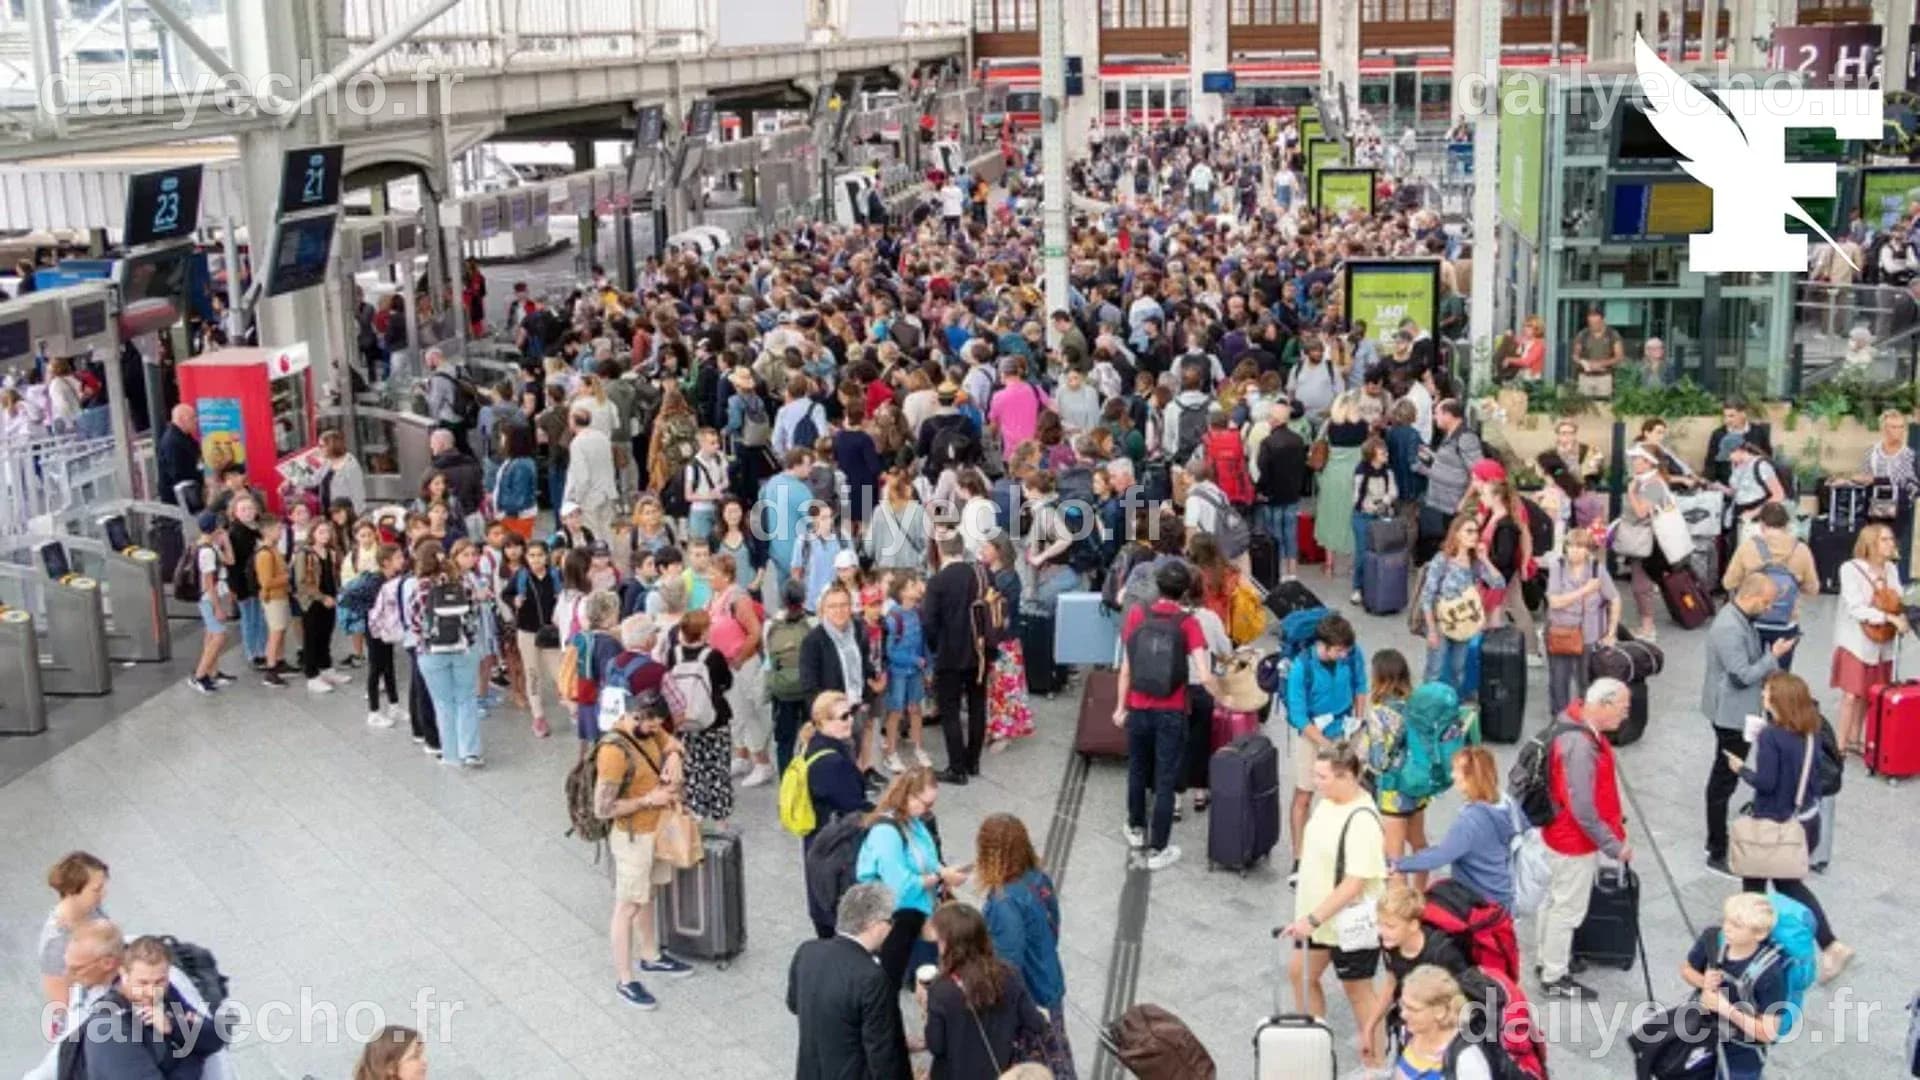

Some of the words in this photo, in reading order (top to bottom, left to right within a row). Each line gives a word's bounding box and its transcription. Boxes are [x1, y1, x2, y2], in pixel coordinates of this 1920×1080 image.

[1799, 44, 1817, 77] 2
[304, 168, 325, 196] 21
[155, 193, 179, 225] 23
